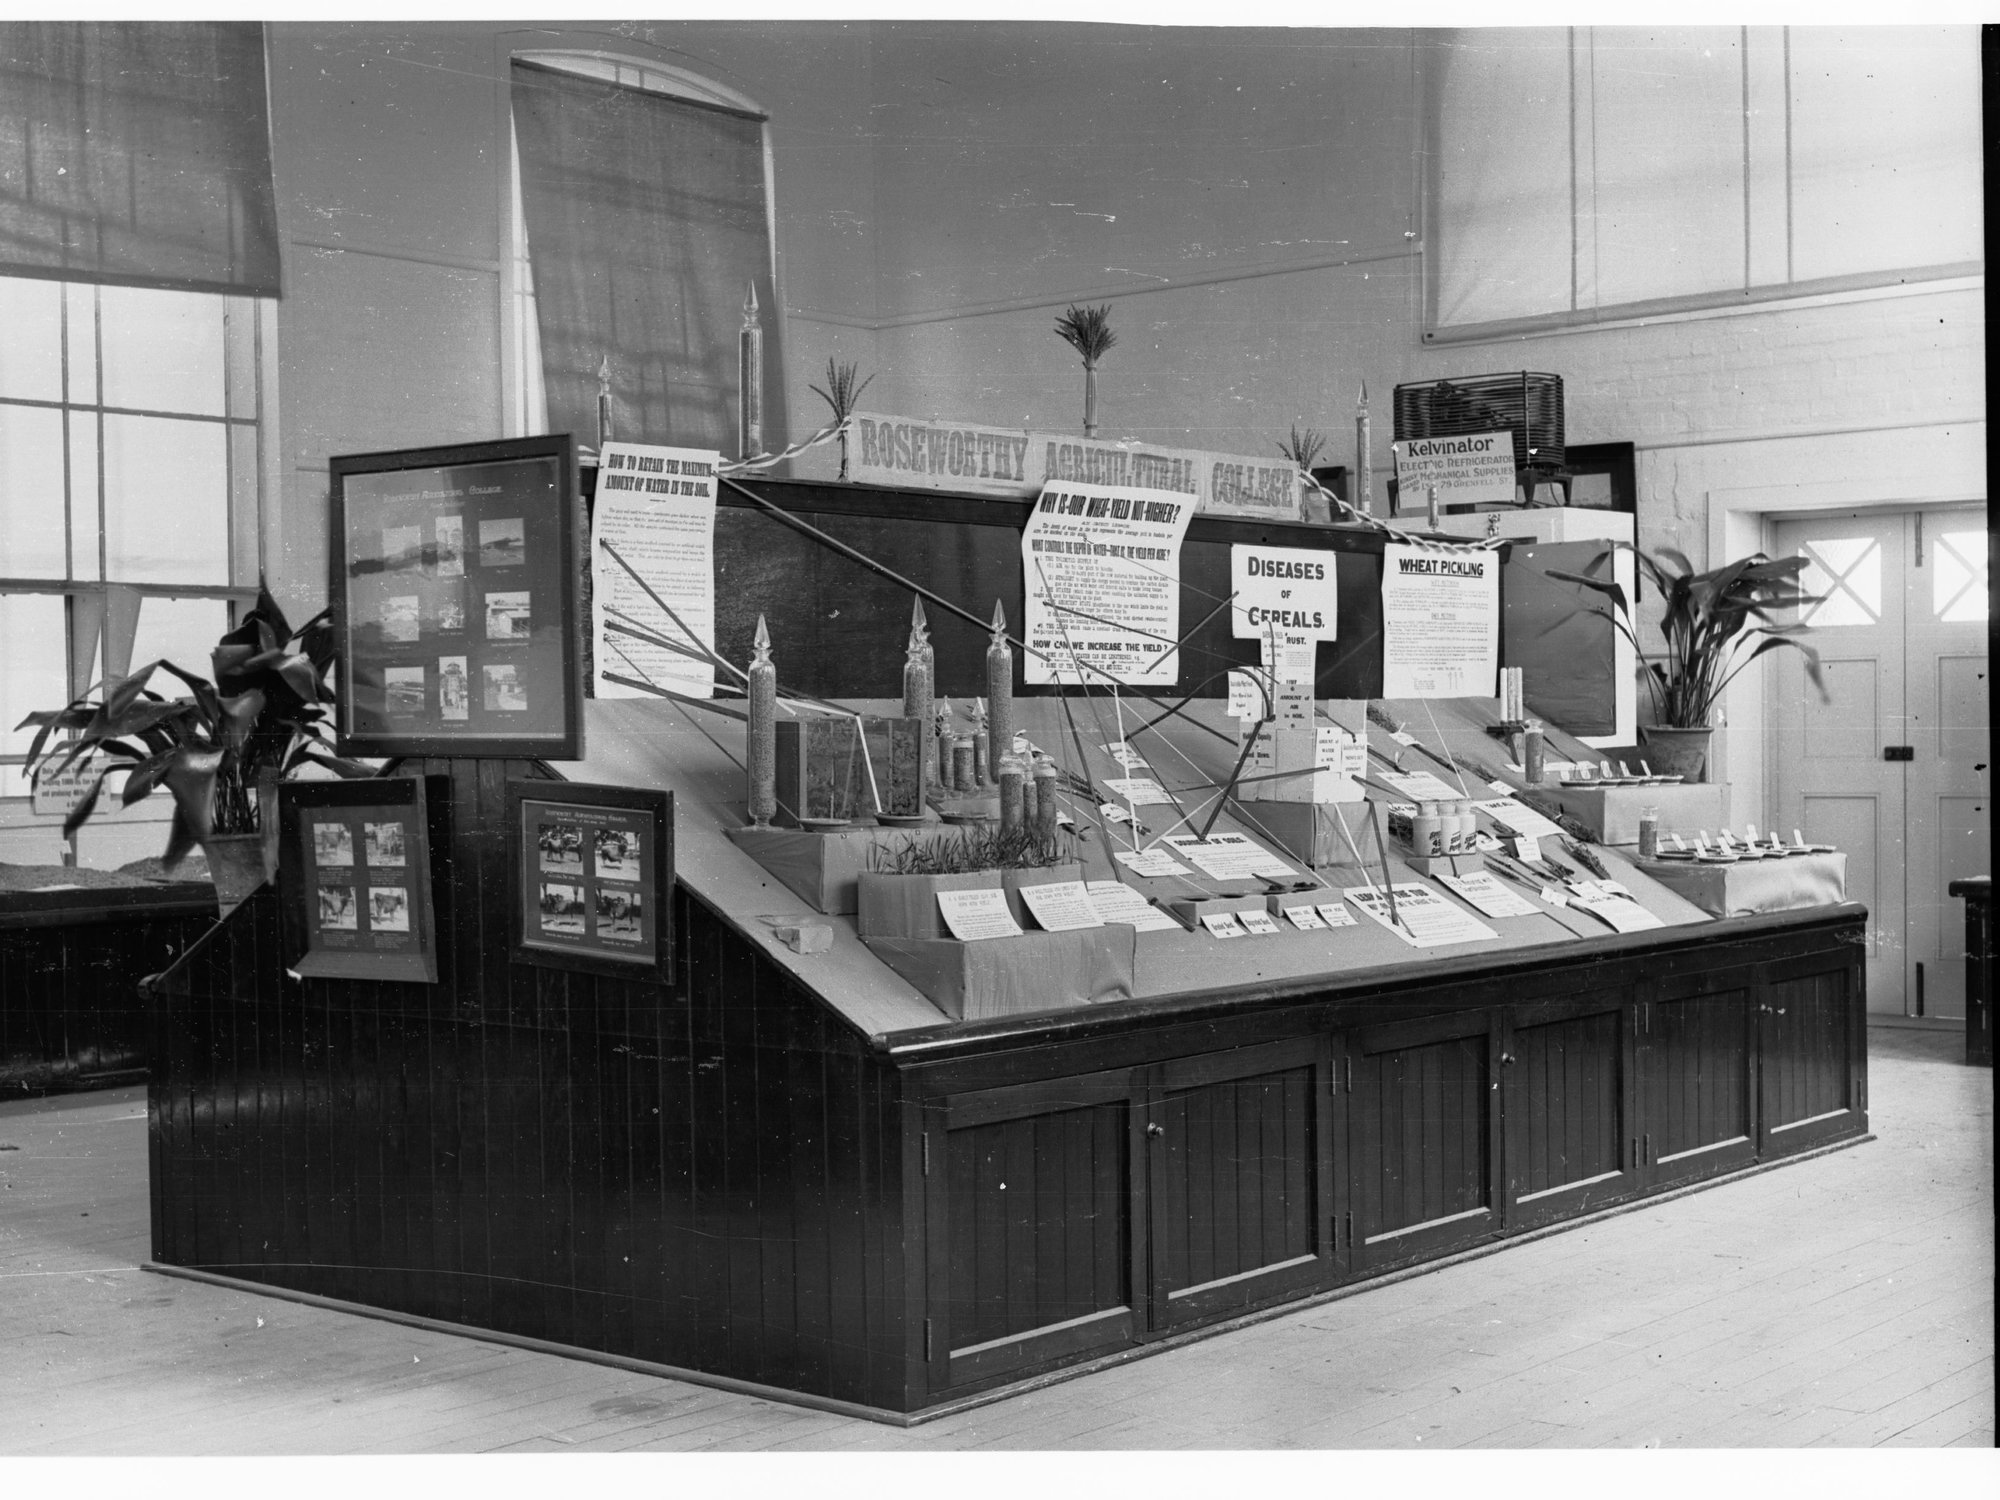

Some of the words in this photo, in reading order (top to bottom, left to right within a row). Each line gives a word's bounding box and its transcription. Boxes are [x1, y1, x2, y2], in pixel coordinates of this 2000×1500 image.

[1408, 437, 1494, 457] Kelvinator
[608, 453, 625, 469] HOW
[627, 455, 636, 470] TO
[638, 456, 665, 473] RETAIN
[666, 459, 680, 475] THE
[680, 460, 712, 477] MAXIMUM
[860, 418, 1028, 481] ROSEWORTHY
[1212, 462, 1294, 508] COLLEGE
[1447, 455, 1515, 468] REFRIGERATOR
[1473, 466, 1514, 477] SUPPLIES
[605, 474, 634, 491] AMOUNT
[634, 477, 645, 492] OF
[645, 478, 670, 494] WATER
[670, 480, 680, 495] IN
[680, 481, 694, 496] THE
[694, 482, 710, 498] SOIL.
[1440, 481, 1452, 489] 79
[1039, 492, 1058, 513] WHY
[1031, 539, 1043, 552] WHAT
[1248, 556, 1324, 580] DISEASES
[1399, 558, 1438, 573] WHEAT
[1441, 561, 1484, 576] PICKLING
[1281, 590, 1292, 598] OF
[1033, 639, 1051, 648] HOW
[1072, 641, 1084, 650] WE
[1087, 642, 1122, 651] INCREASE
[1125, 643, 1140, 652] THE
[1286, 637, 1306, 645] RUST.
